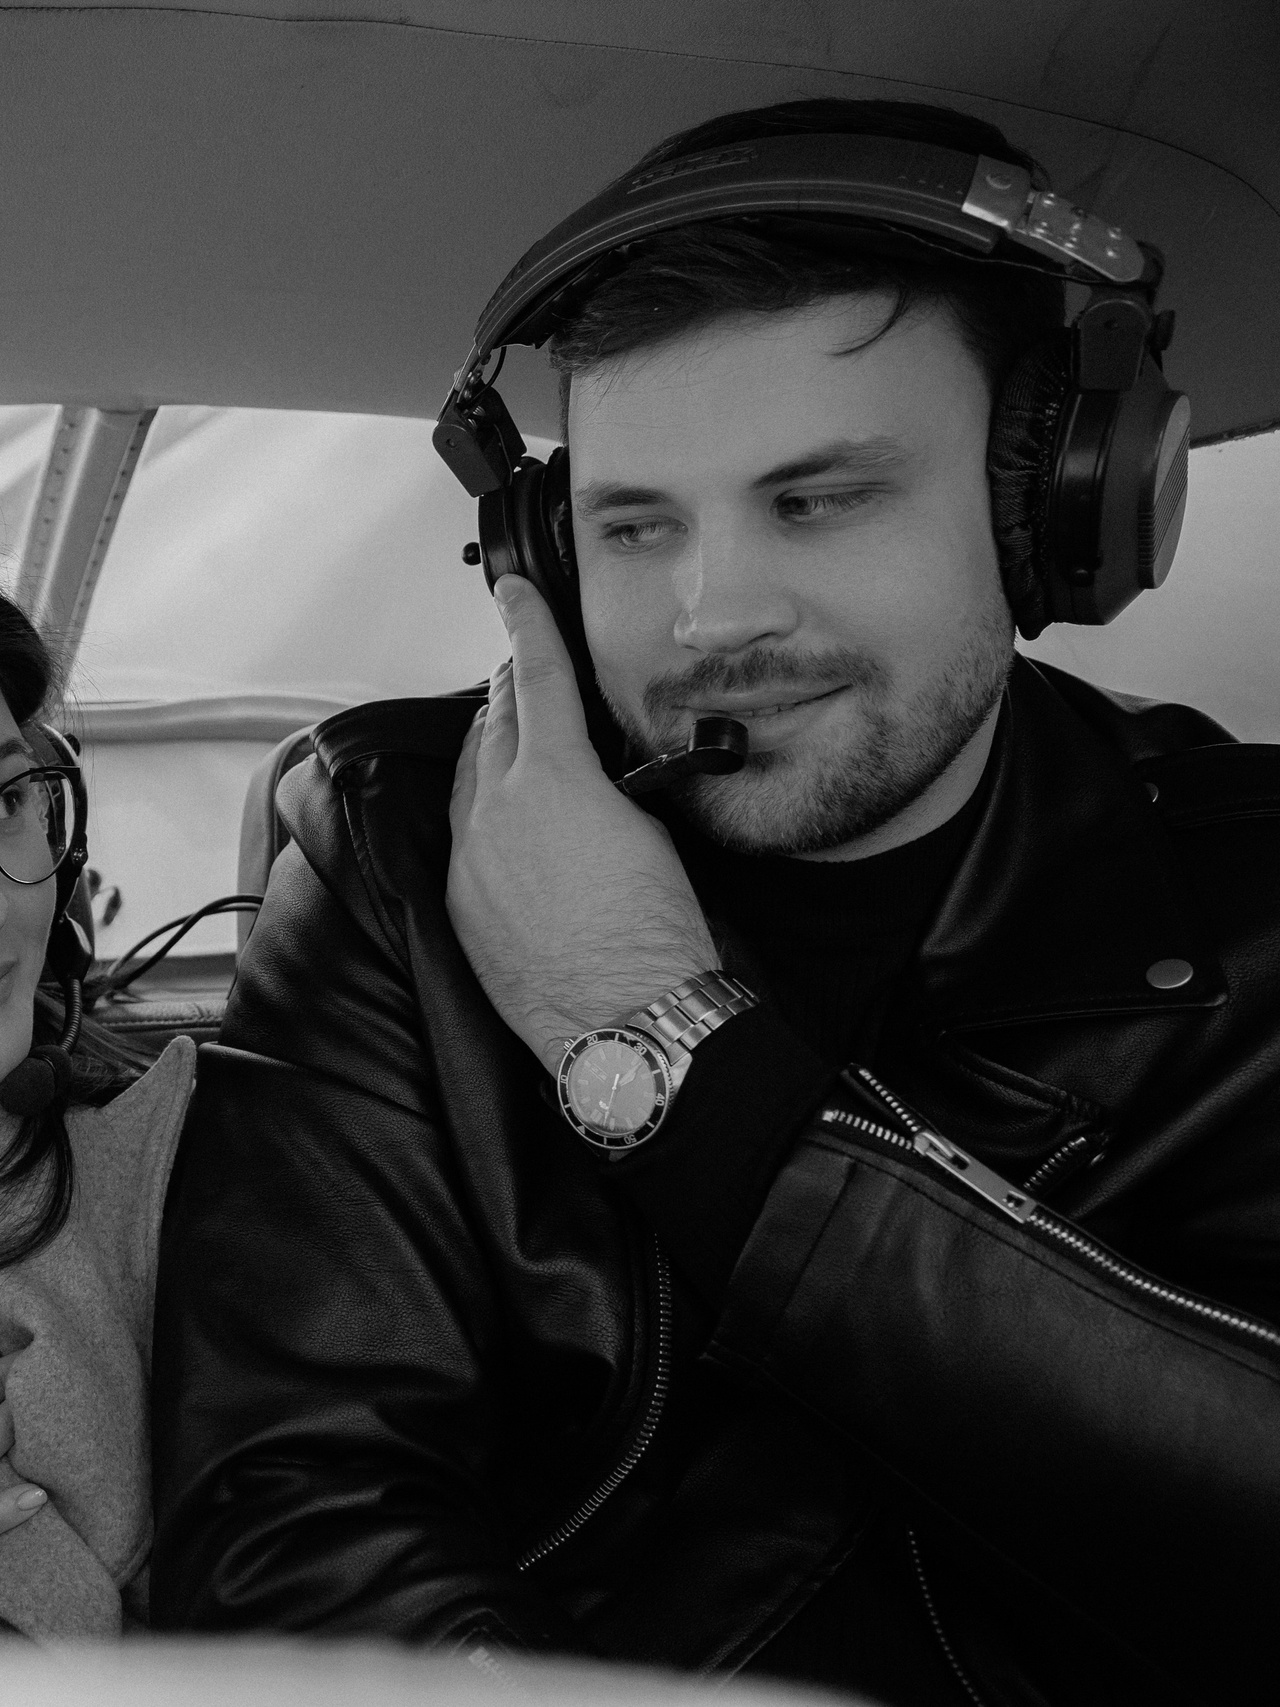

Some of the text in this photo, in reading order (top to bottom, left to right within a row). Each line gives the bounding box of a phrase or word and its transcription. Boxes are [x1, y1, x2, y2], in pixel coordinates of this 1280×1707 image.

[586, 1034, 599, 1045] 20
[634, 1043, 647, 1055] 30
[560, 1075, 567, 1084] 10
[656, 1093, 665, 1106] 40
[624, 1134, 637, 1145] 50
